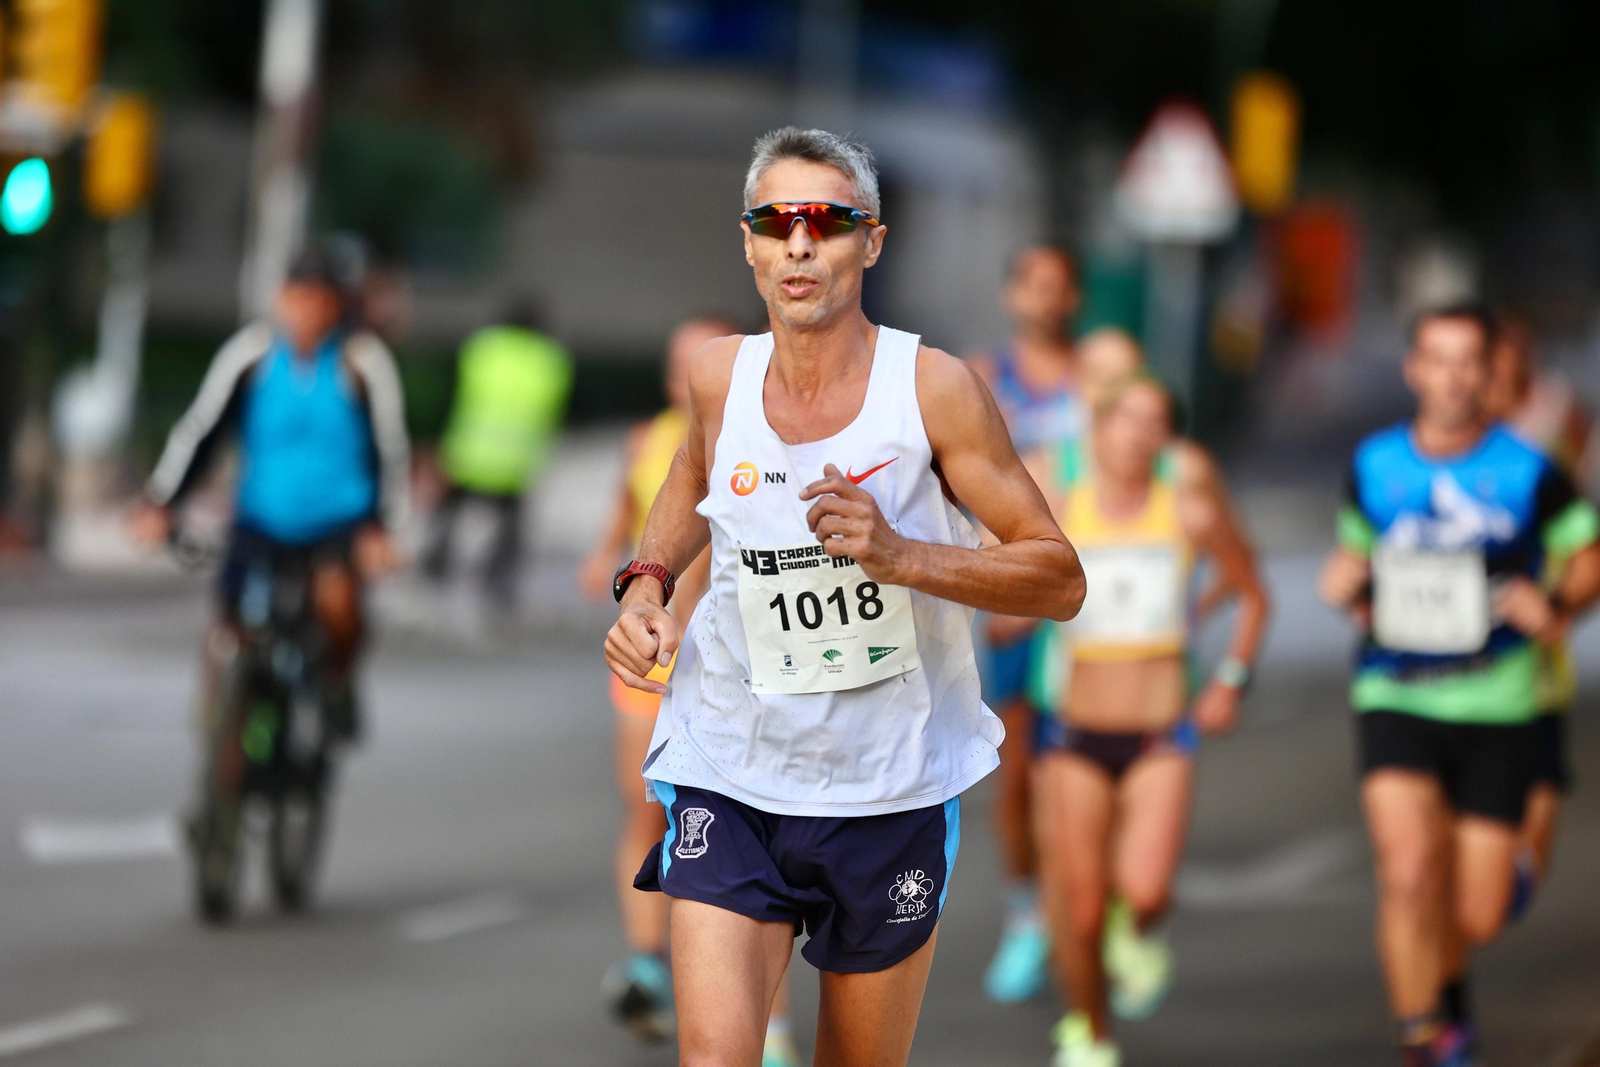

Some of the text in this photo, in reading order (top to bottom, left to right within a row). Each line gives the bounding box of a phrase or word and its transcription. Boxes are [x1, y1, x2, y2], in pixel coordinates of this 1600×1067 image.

[764, 472, 786, 484] NN
[740, 549, 779, 575] 43
[780, 559, 820, 570] CIUDAD
[769, 581, 884, 631] 1018
[896, 869, 925, 885] CMD
[895, 901, 927, 915] NERJA
